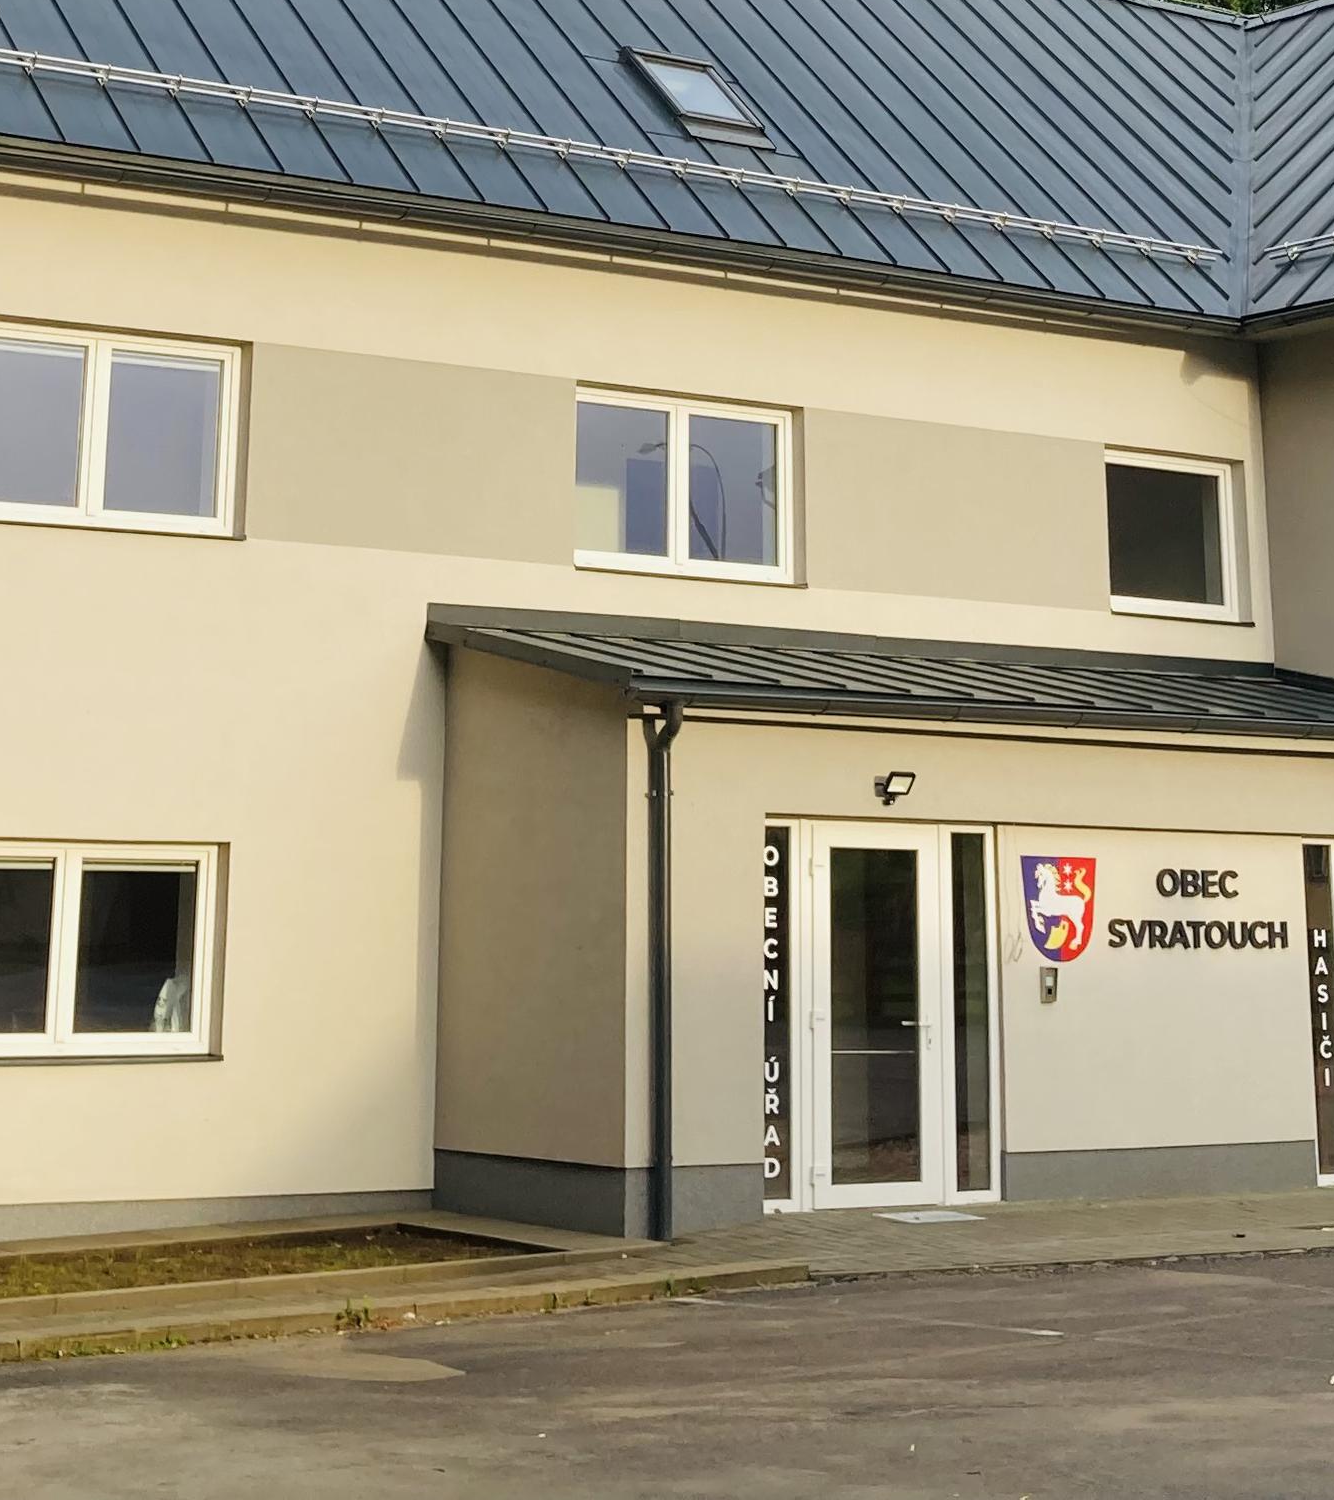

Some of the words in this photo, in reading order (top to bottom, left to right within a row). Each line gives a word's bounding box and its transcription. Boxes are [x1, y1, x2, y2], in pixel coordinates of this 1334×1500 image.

[763, 845, 780, 1022] OBECNÍ
[1108, 918, 1289, 949] SVRATOUCH
[1156, 868, 1239, 899] OBEC
[1313, 929, 1332, 1086] HASIČI
[763, 1056, 781, 1179] ÚŘAD
